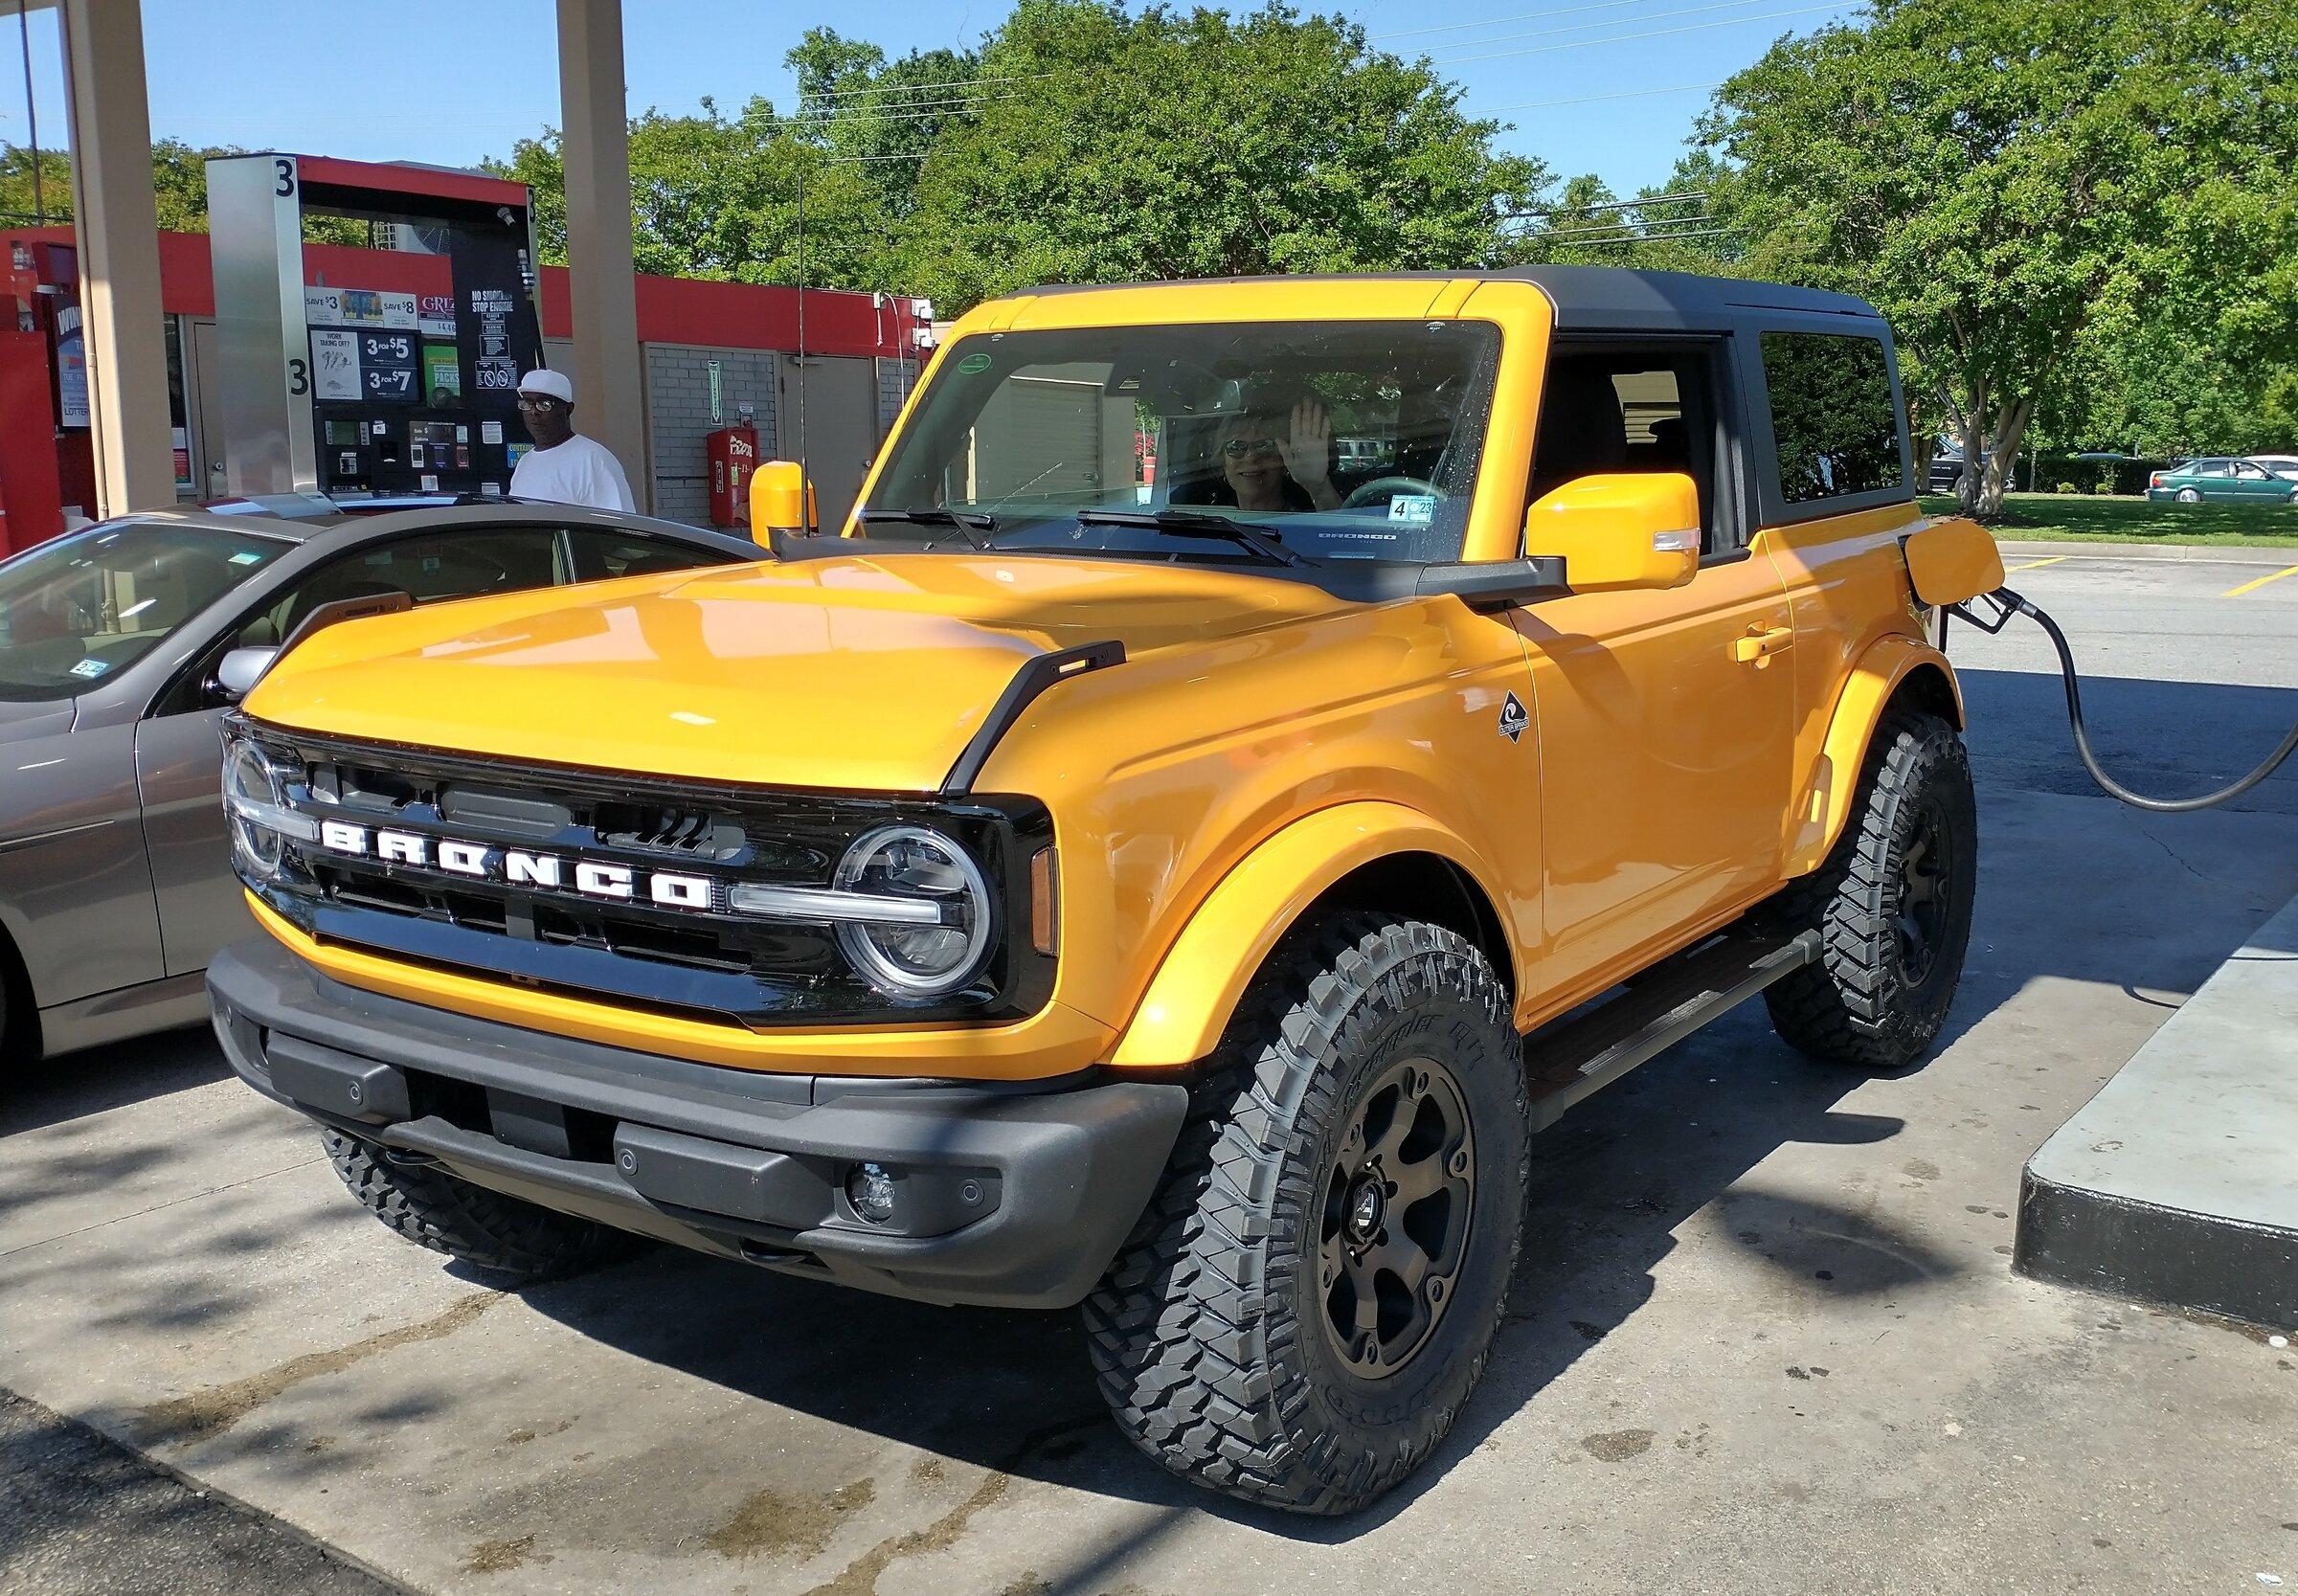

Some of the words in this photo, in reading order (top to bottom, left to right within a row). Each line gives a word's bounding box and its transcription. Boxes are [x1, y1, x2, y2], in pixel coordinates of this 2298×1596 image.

[275, 159, 295, 198] 3
[305, 298, 324, 306] SAVE
[326, 296, 338, 309] $3
[471, 290, 482, 302] NO
[383, 303, 402, 311] SAVE
[402, 302, 415, 315] $8
[472, 302, 488, 313] STOP
[367, 338, 379, 356] 3
[390, 337, 409, 359] $5
[288, 359, 309, 396] 3
[369, 371, 382, 389] 3
[392, 371, 412, 392] $7
[1394, 501, 1406, 517] 4
[1419, 502, 1432, 514] 23
[322, 820, 711, 909] BRONCO
